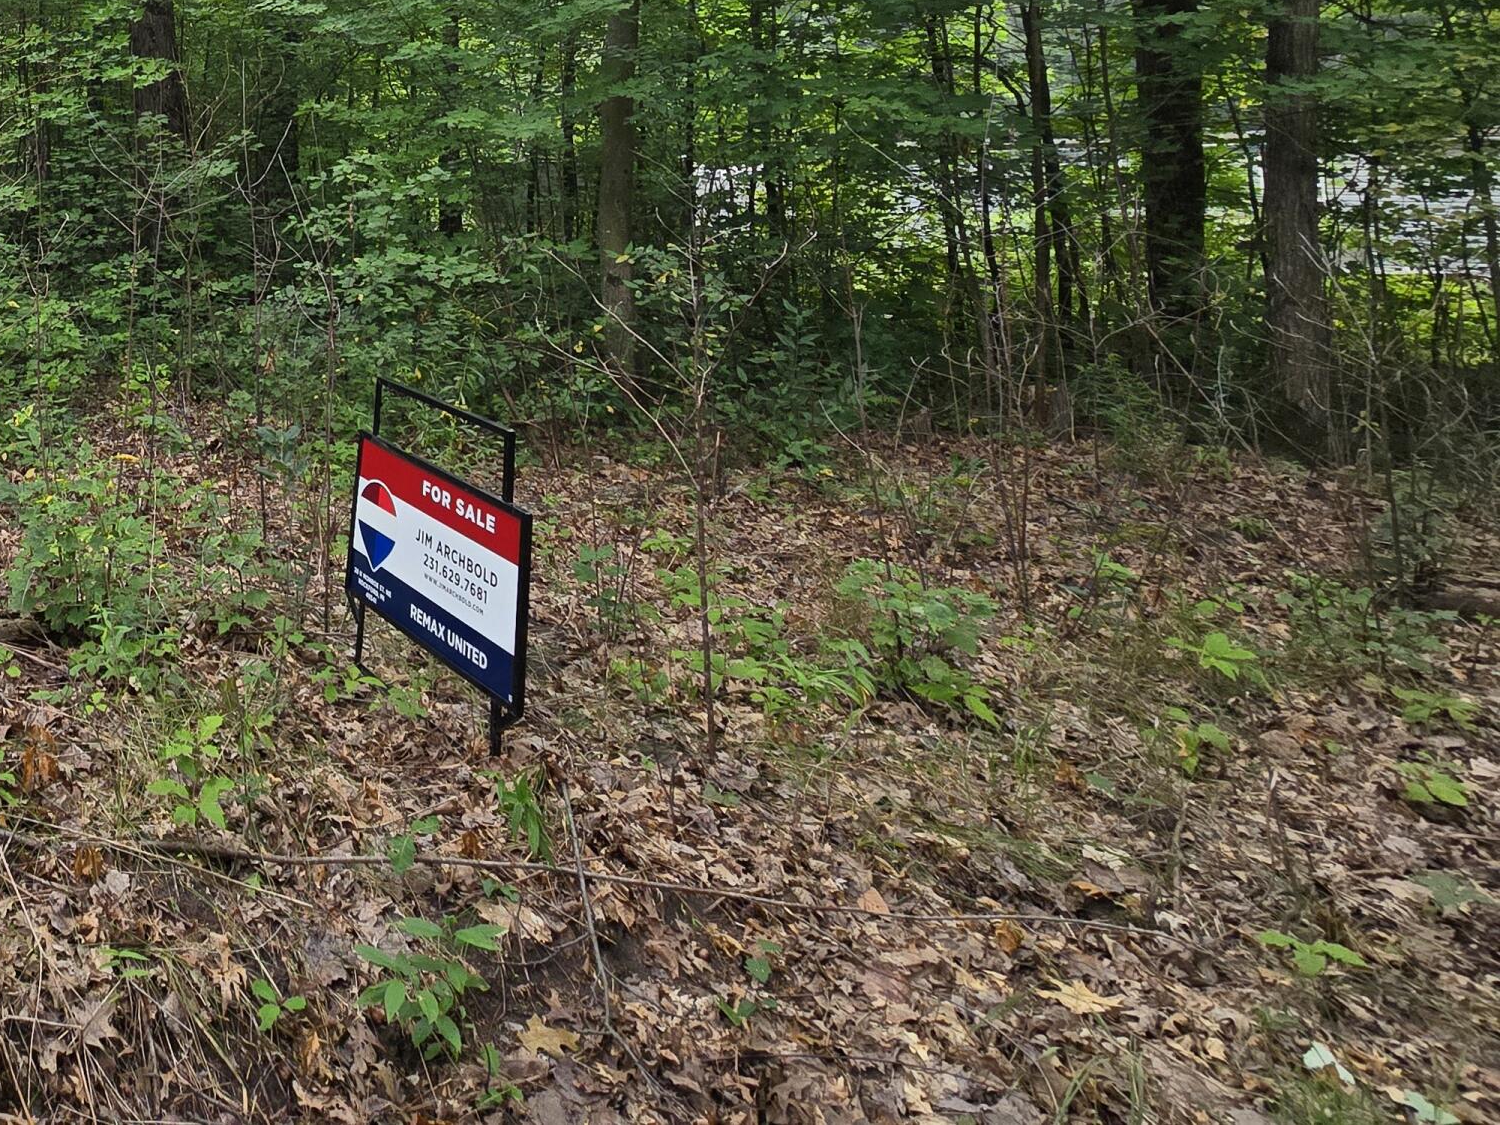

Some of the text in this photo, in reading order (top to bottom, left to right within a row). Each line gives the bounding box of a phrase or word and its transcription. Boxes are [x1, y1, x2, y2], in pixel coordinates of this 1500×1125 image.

[421, 479, 497, 535] FOR SALE
[415, 528, 498, 588] JIM ARCHBOLD
[423, 553, 488, 605] 231.629.7681
[409, 603, 489, 671] REMAX UNITED
